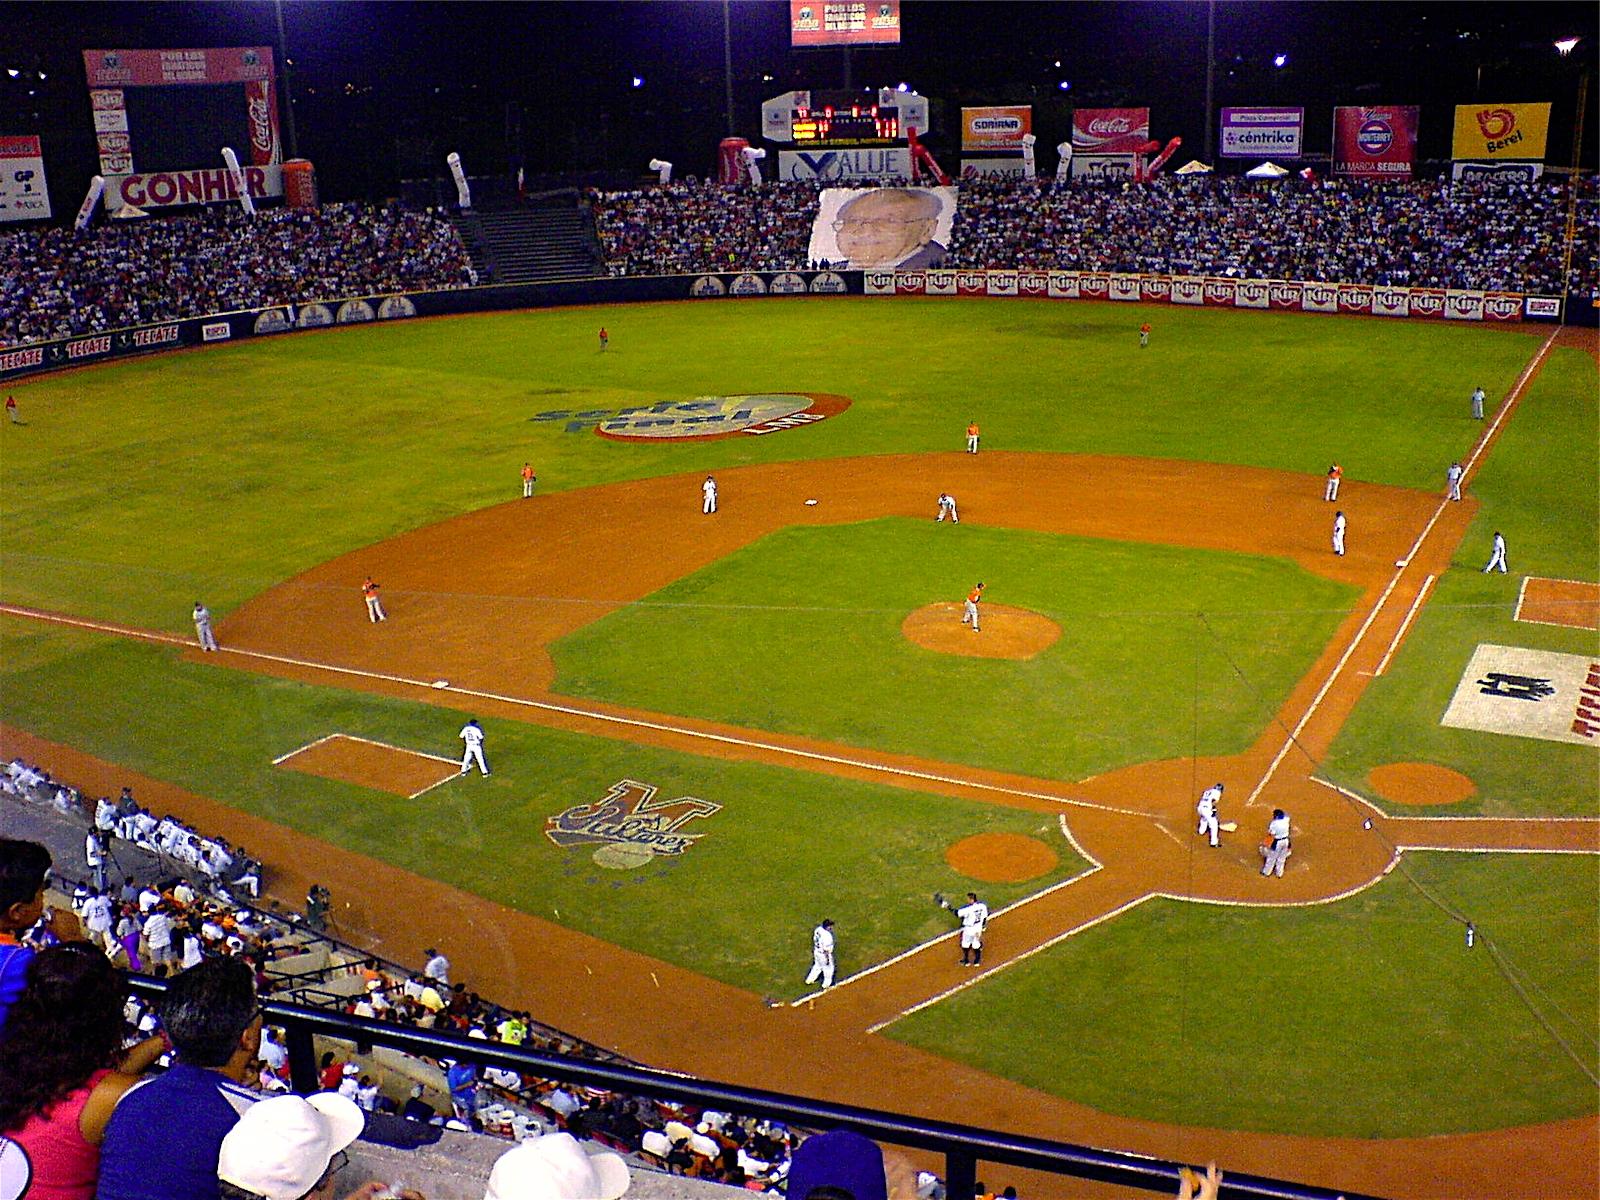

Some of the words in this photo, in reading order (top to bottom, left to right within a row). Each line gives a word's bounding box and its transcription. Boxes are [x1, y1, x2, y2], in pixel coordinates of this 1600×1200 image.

[1238, 130, 1295, 143] céntrika
[1486, 129, 1523, 153] Berel
[1347, 161, 1375, 171] MARCA
[1376, 161, 1412, 172] SEGURA
[133, 325, 179, 346] TECATE
[65, 336, 111, 359] TECATE
